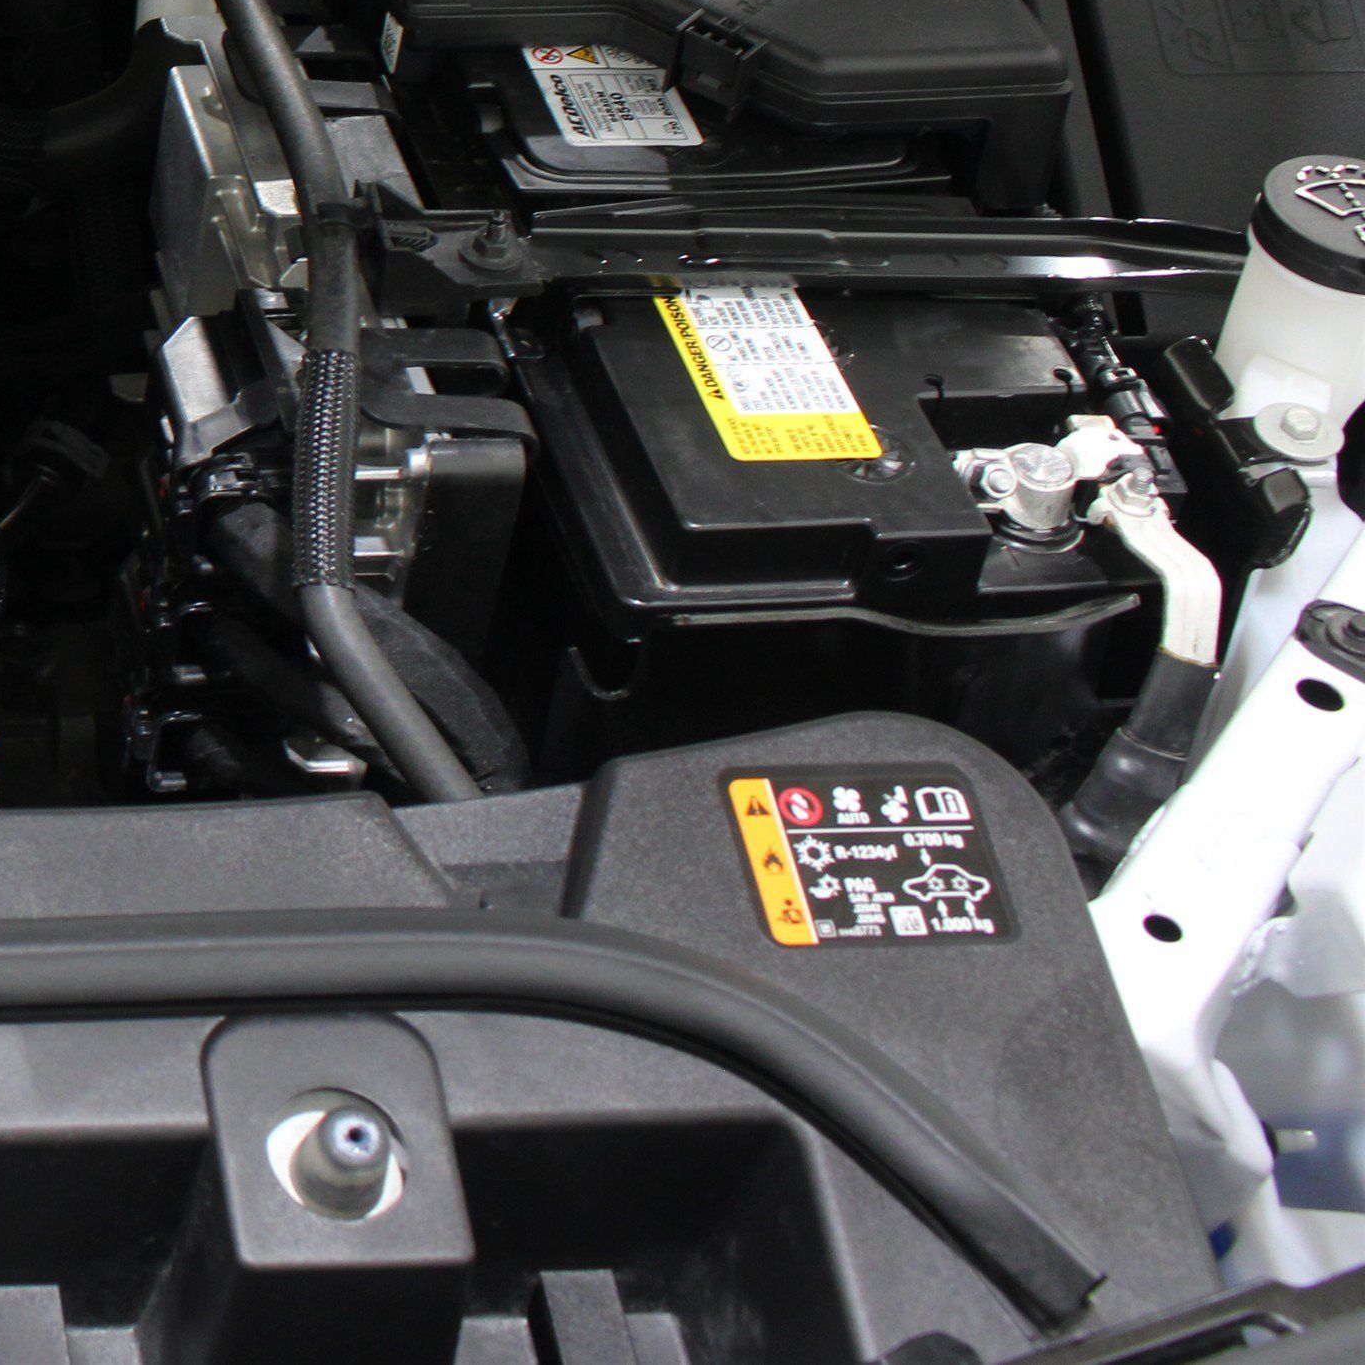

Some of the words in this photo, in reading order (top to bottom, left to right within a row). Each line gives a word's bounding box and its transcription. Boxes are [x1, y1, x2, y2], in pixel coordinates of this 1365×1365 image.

[550, 73, 591, 136] ACDelco
[836, 812, 871, 825] AUTO
[943, 833, 965, 850] kg
[843, 876, 878, 893] PAG
